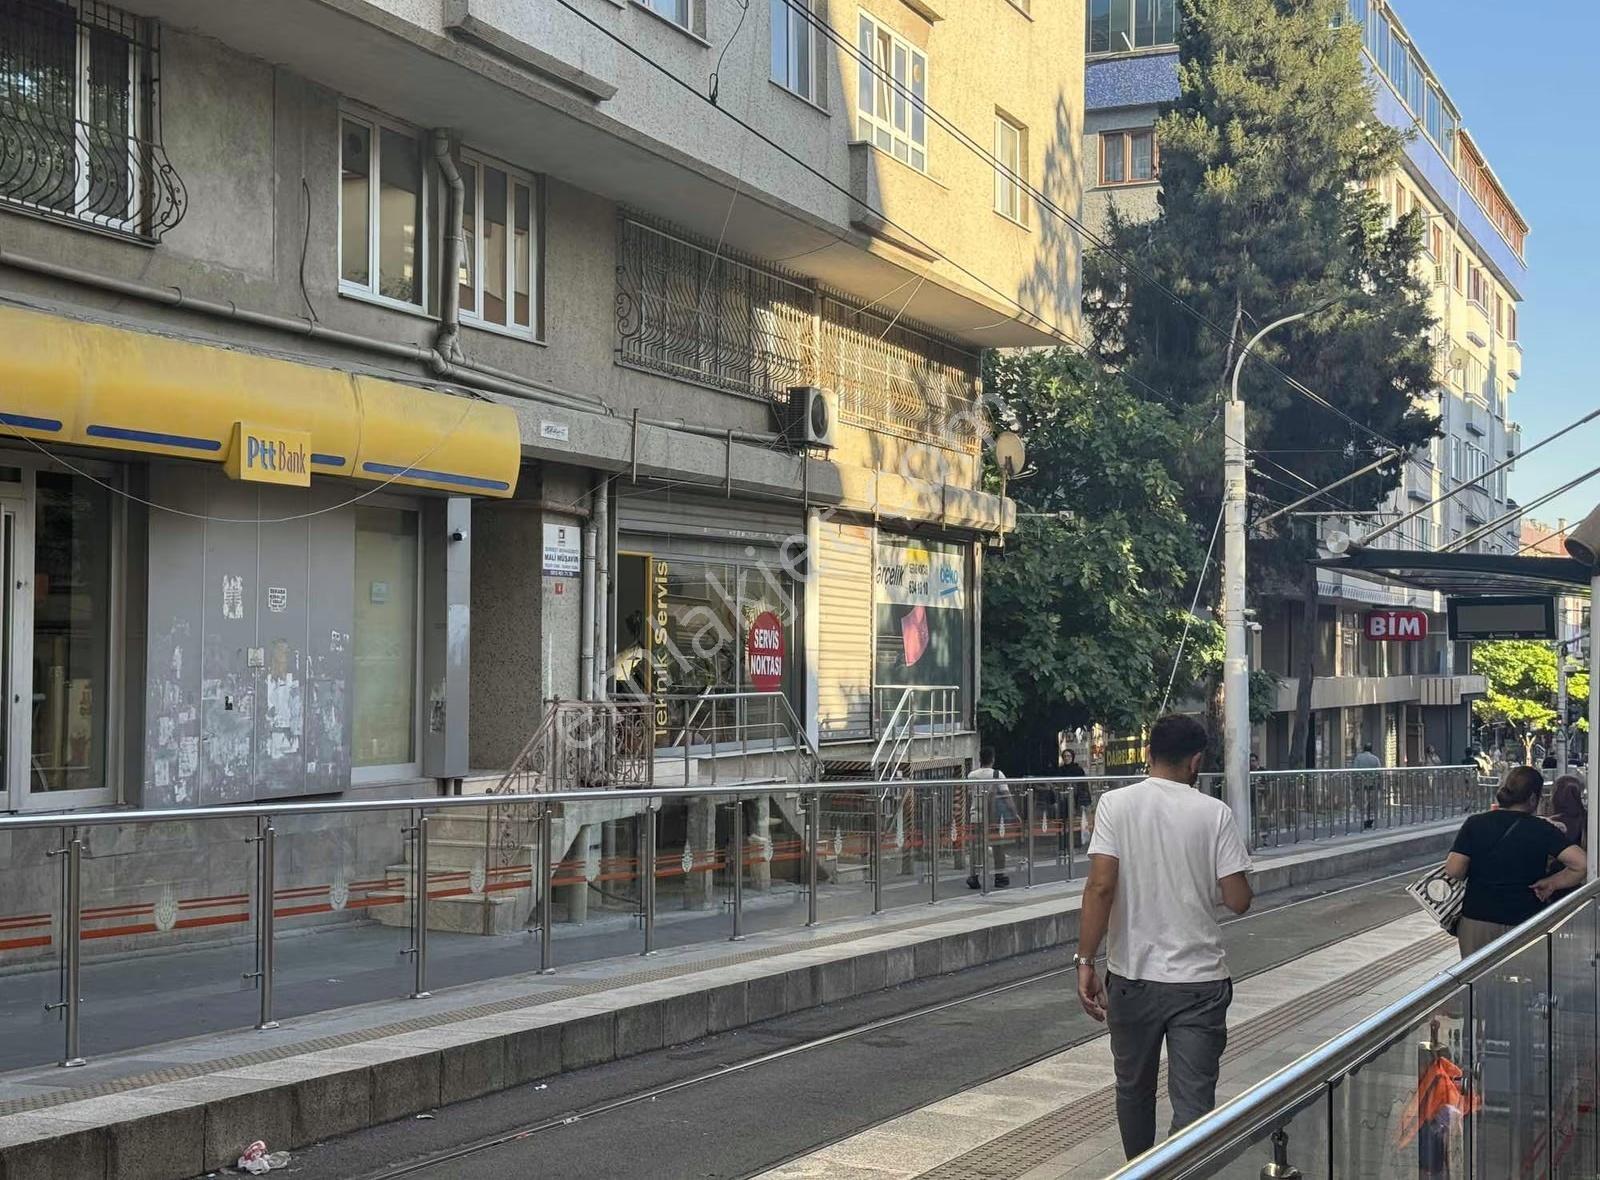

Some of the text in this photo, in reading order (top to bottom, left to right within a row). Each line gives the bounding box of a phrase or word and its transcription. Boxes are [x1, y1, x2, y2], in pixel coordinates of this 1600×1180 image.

[654, 561, 668, 645] Servis
[1370, 611, 1420, 636] BİM
[754, 625, 779, 650] SERVİS
[750, 654, 782, 676] NOKTASI
